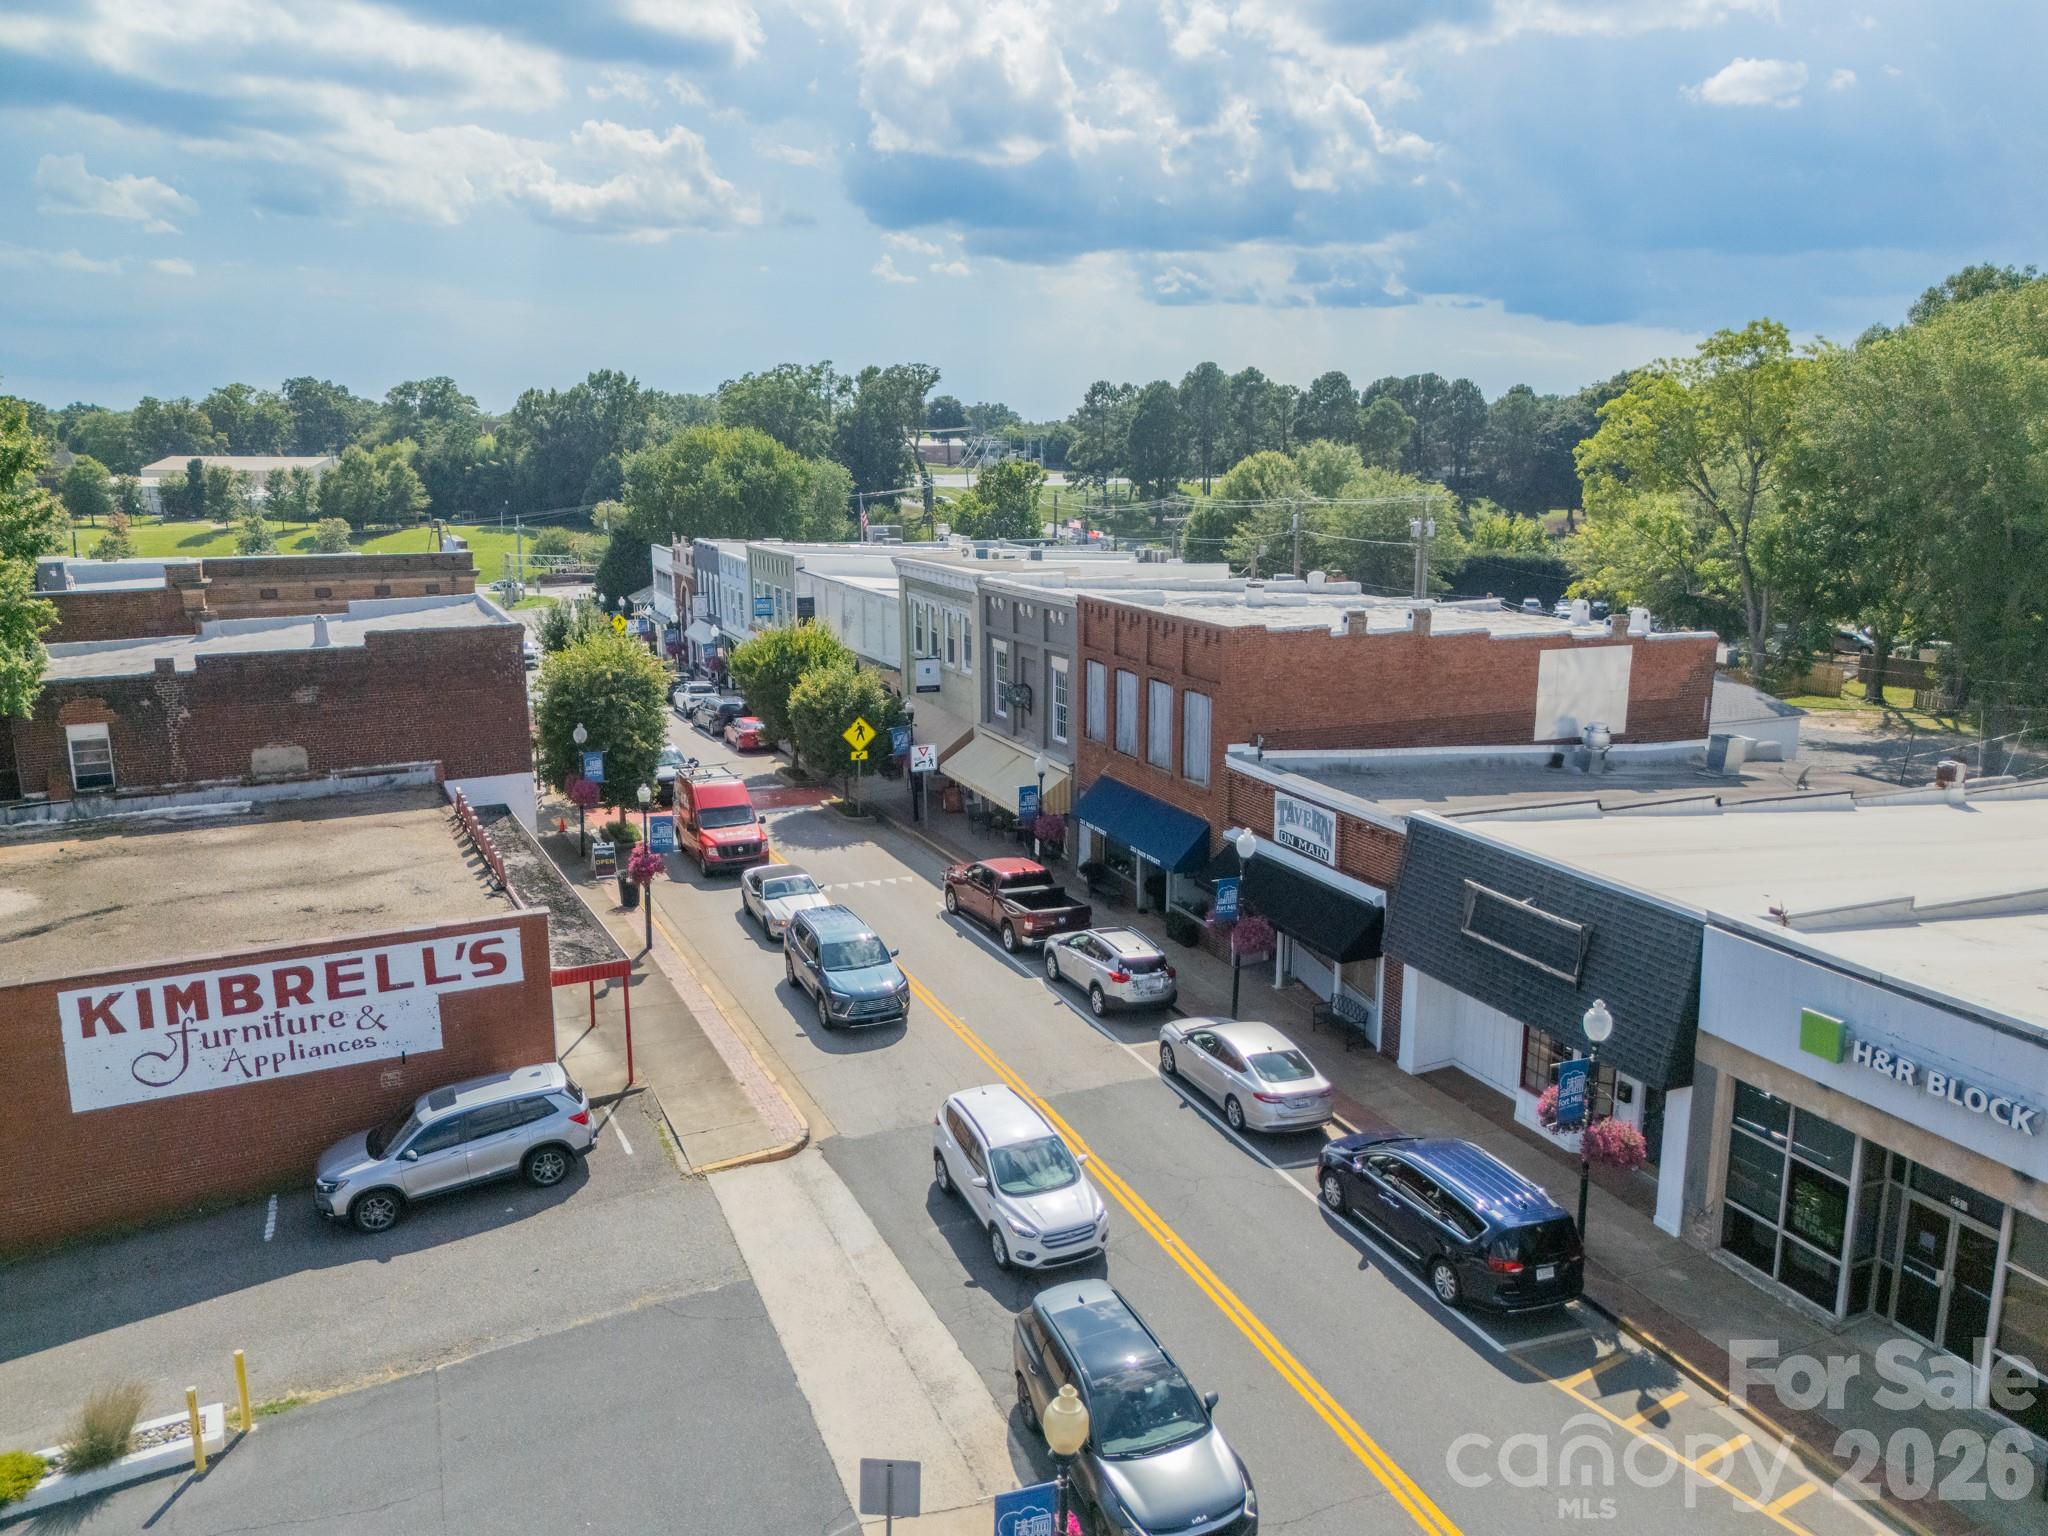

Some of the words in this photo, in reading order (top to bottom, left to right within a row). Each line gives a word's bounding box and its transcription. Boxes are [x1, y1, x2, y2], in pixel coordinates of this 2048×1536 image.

[1277, 799, 1334, 848] TAVERN
[1280, 831, 1295, 846] ON
[1298, 838, 1328, 860] MAIN
[76, 937, 507, 1039] KIMBRELL'S
[356, 1005, 388, 1031] &
[222, 1034, 377, 1078] Appliances
[1559, 1098, 1570, 1107] Fort
[1852, 1040, 1917, 1087] H&R
[1926, 1069, 2037, 1136] BLOCK
